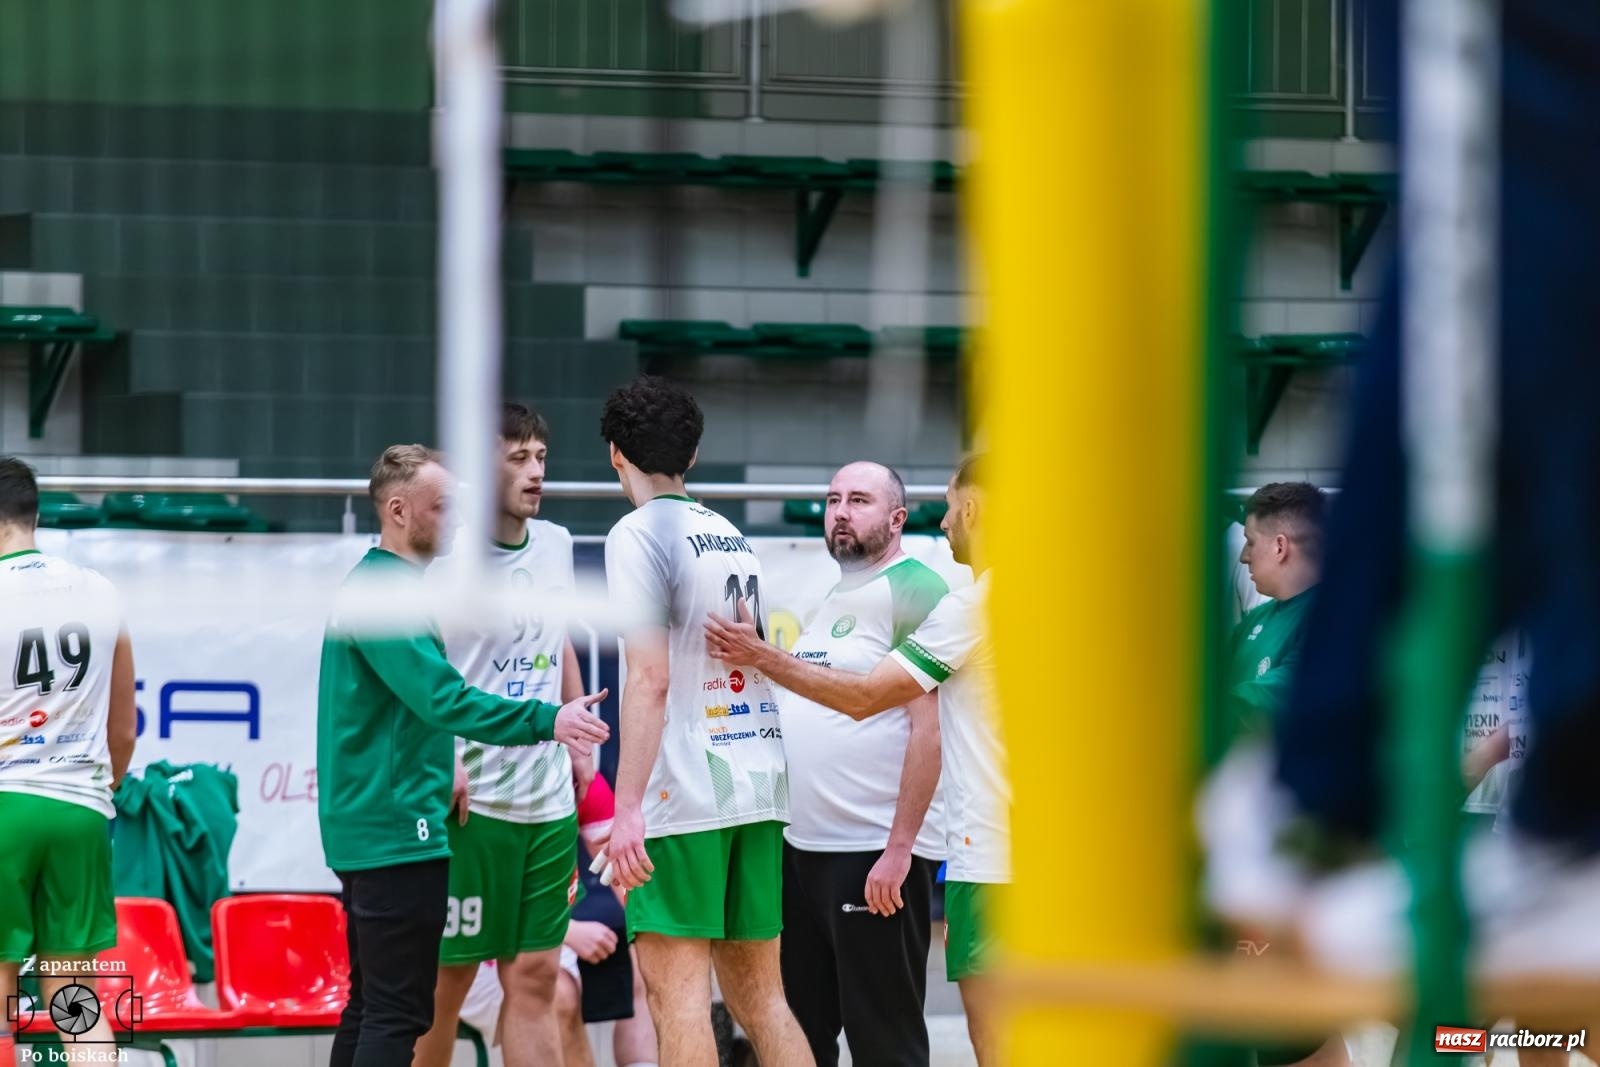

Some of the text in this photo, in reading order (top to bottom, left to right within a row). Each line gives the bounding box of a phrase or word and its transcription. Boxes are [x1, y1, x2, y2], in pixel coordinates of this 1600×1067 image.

[725, 574, 766, 641] 11
[14, 621, 91, 696] 49
[801, 651, 828, 659] CONCEPT
[416, 817, 430, 841] 8
